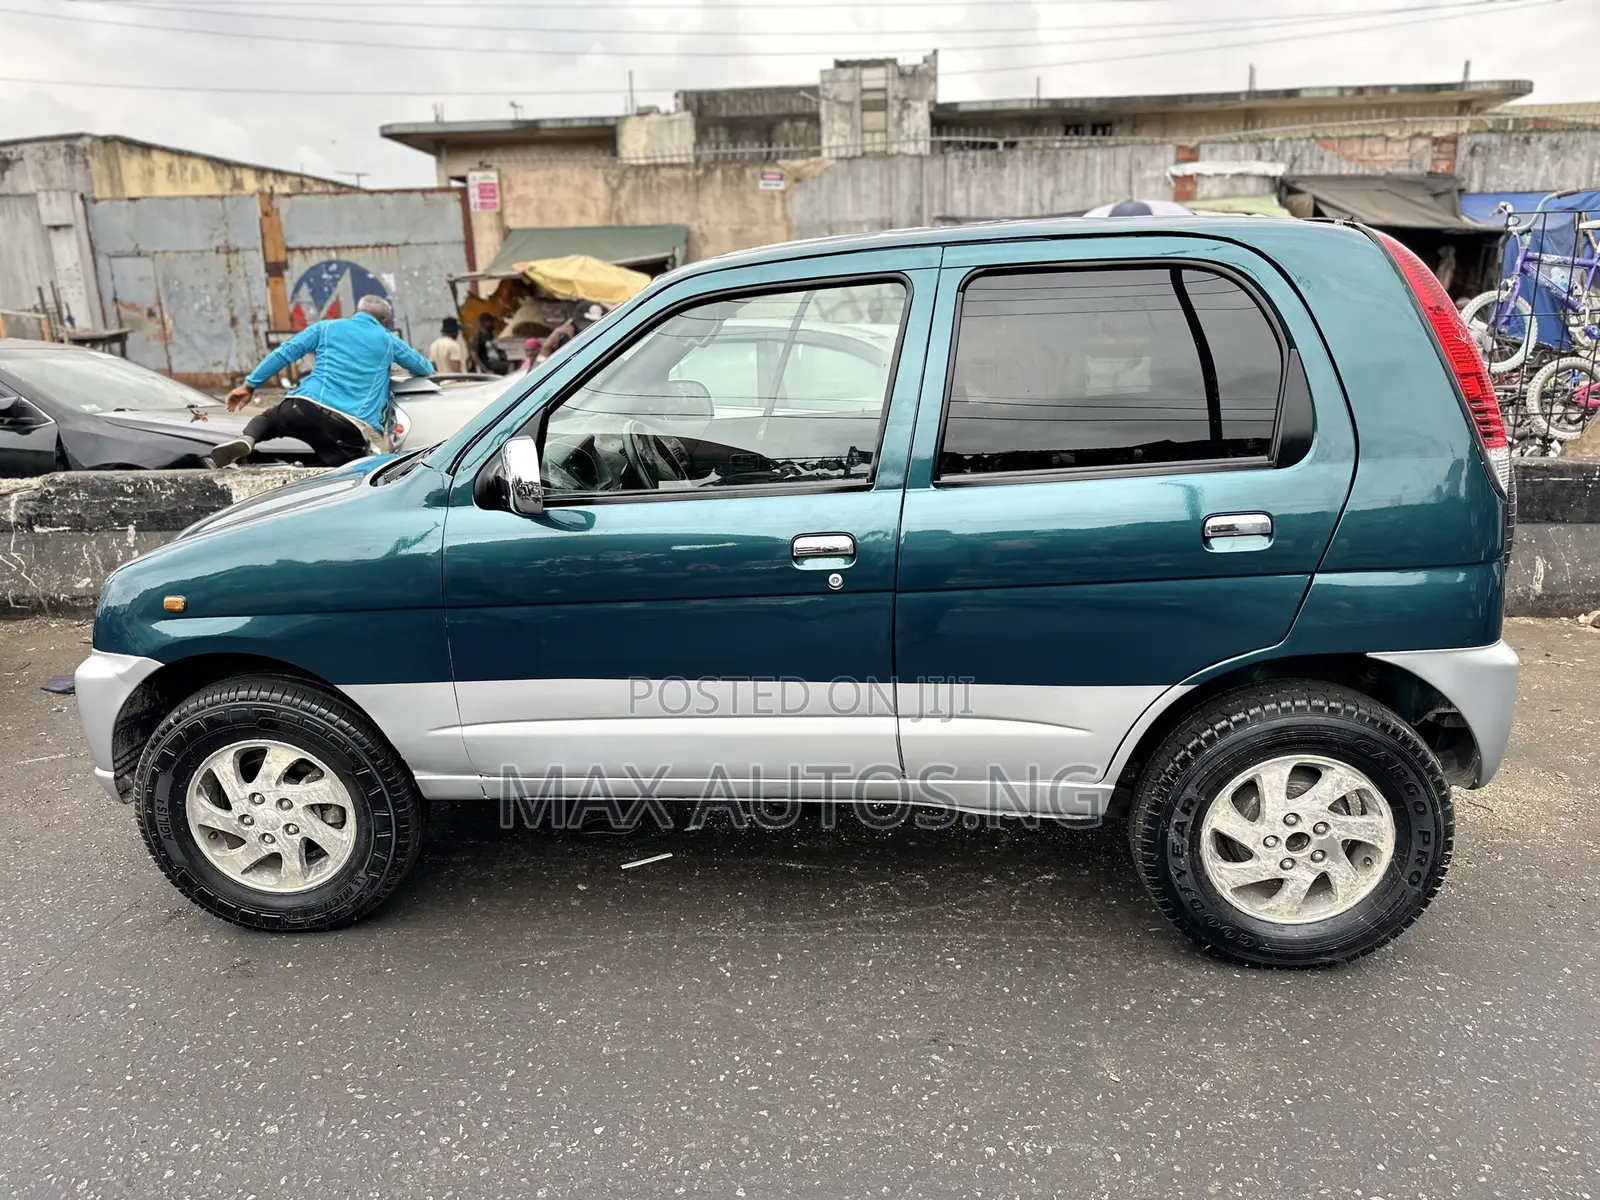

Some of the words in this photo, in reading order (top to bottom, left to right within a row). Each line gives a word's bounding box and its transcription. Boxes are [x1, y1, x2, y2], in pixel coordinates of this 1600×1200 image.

[1171, 797, 1255, 947] GOODYEAR
[1354, 739, 1427, 815] CARGO
[1407, 829, 1431, 886] PRO
